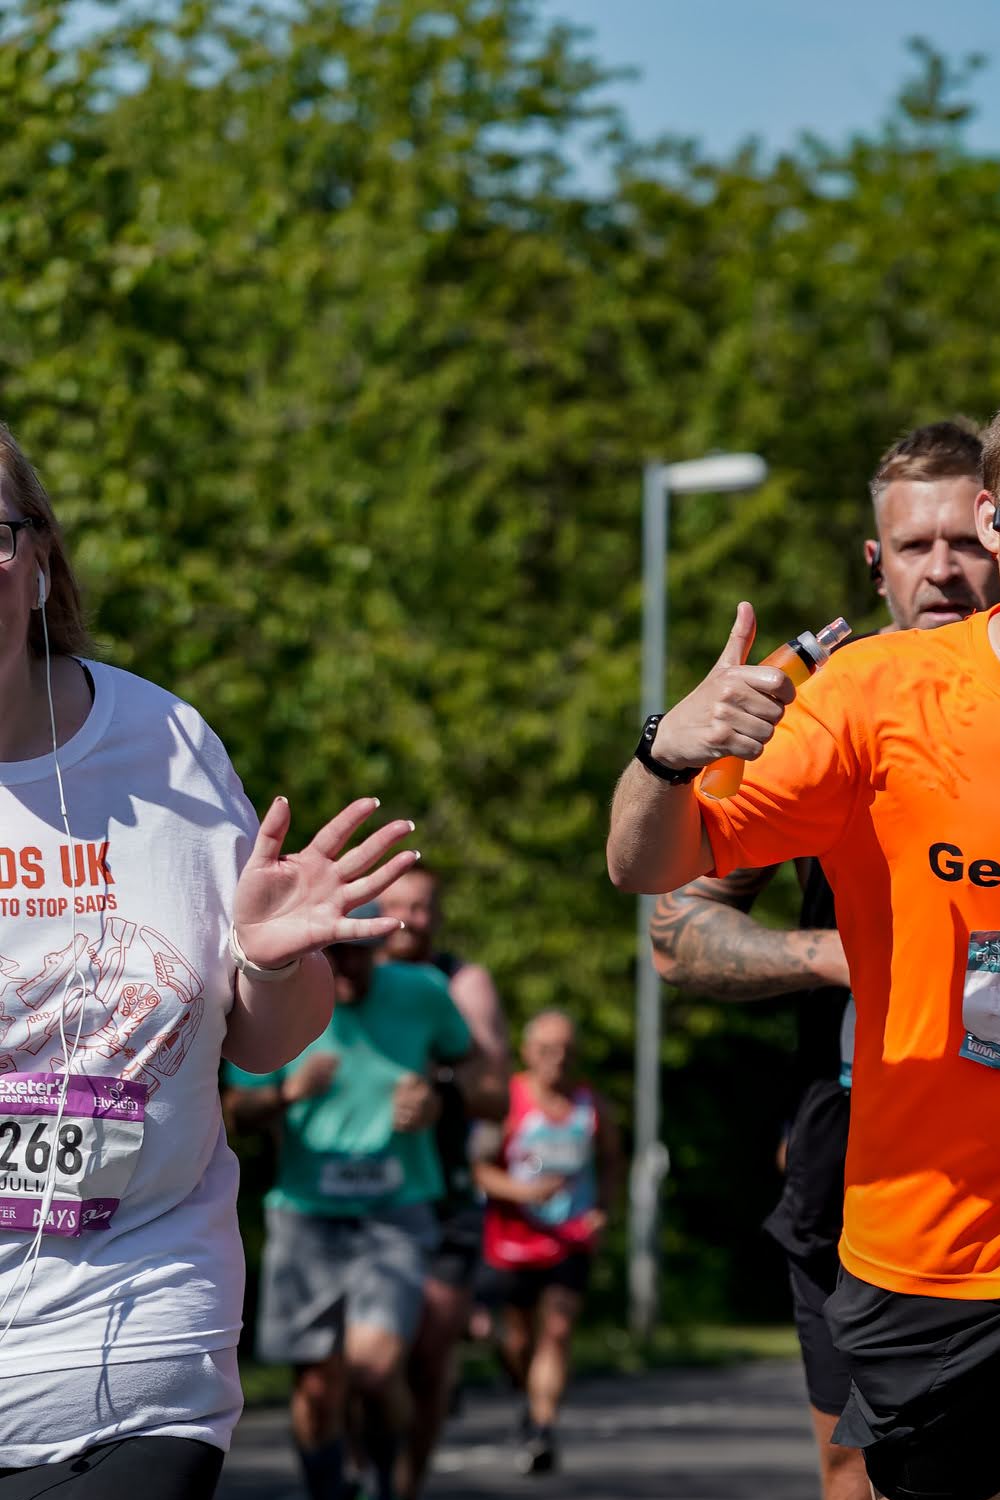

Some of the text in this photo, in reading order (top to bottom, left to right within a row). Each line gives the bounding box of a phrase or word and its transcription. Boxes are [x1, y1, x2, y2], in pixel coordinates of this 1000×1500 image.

[0, 842, 115, 889] DS UK
[0, 894, 117, 918] TO STOP SADS
[24, 1096, 49, 1106] west
[50, 1097, 68, 1106] ru
[93, 1096, 139, 1112] Elysium
[0, 1121, 83, 1175] 268
[32, 1208, 76, 1229] DAYS
